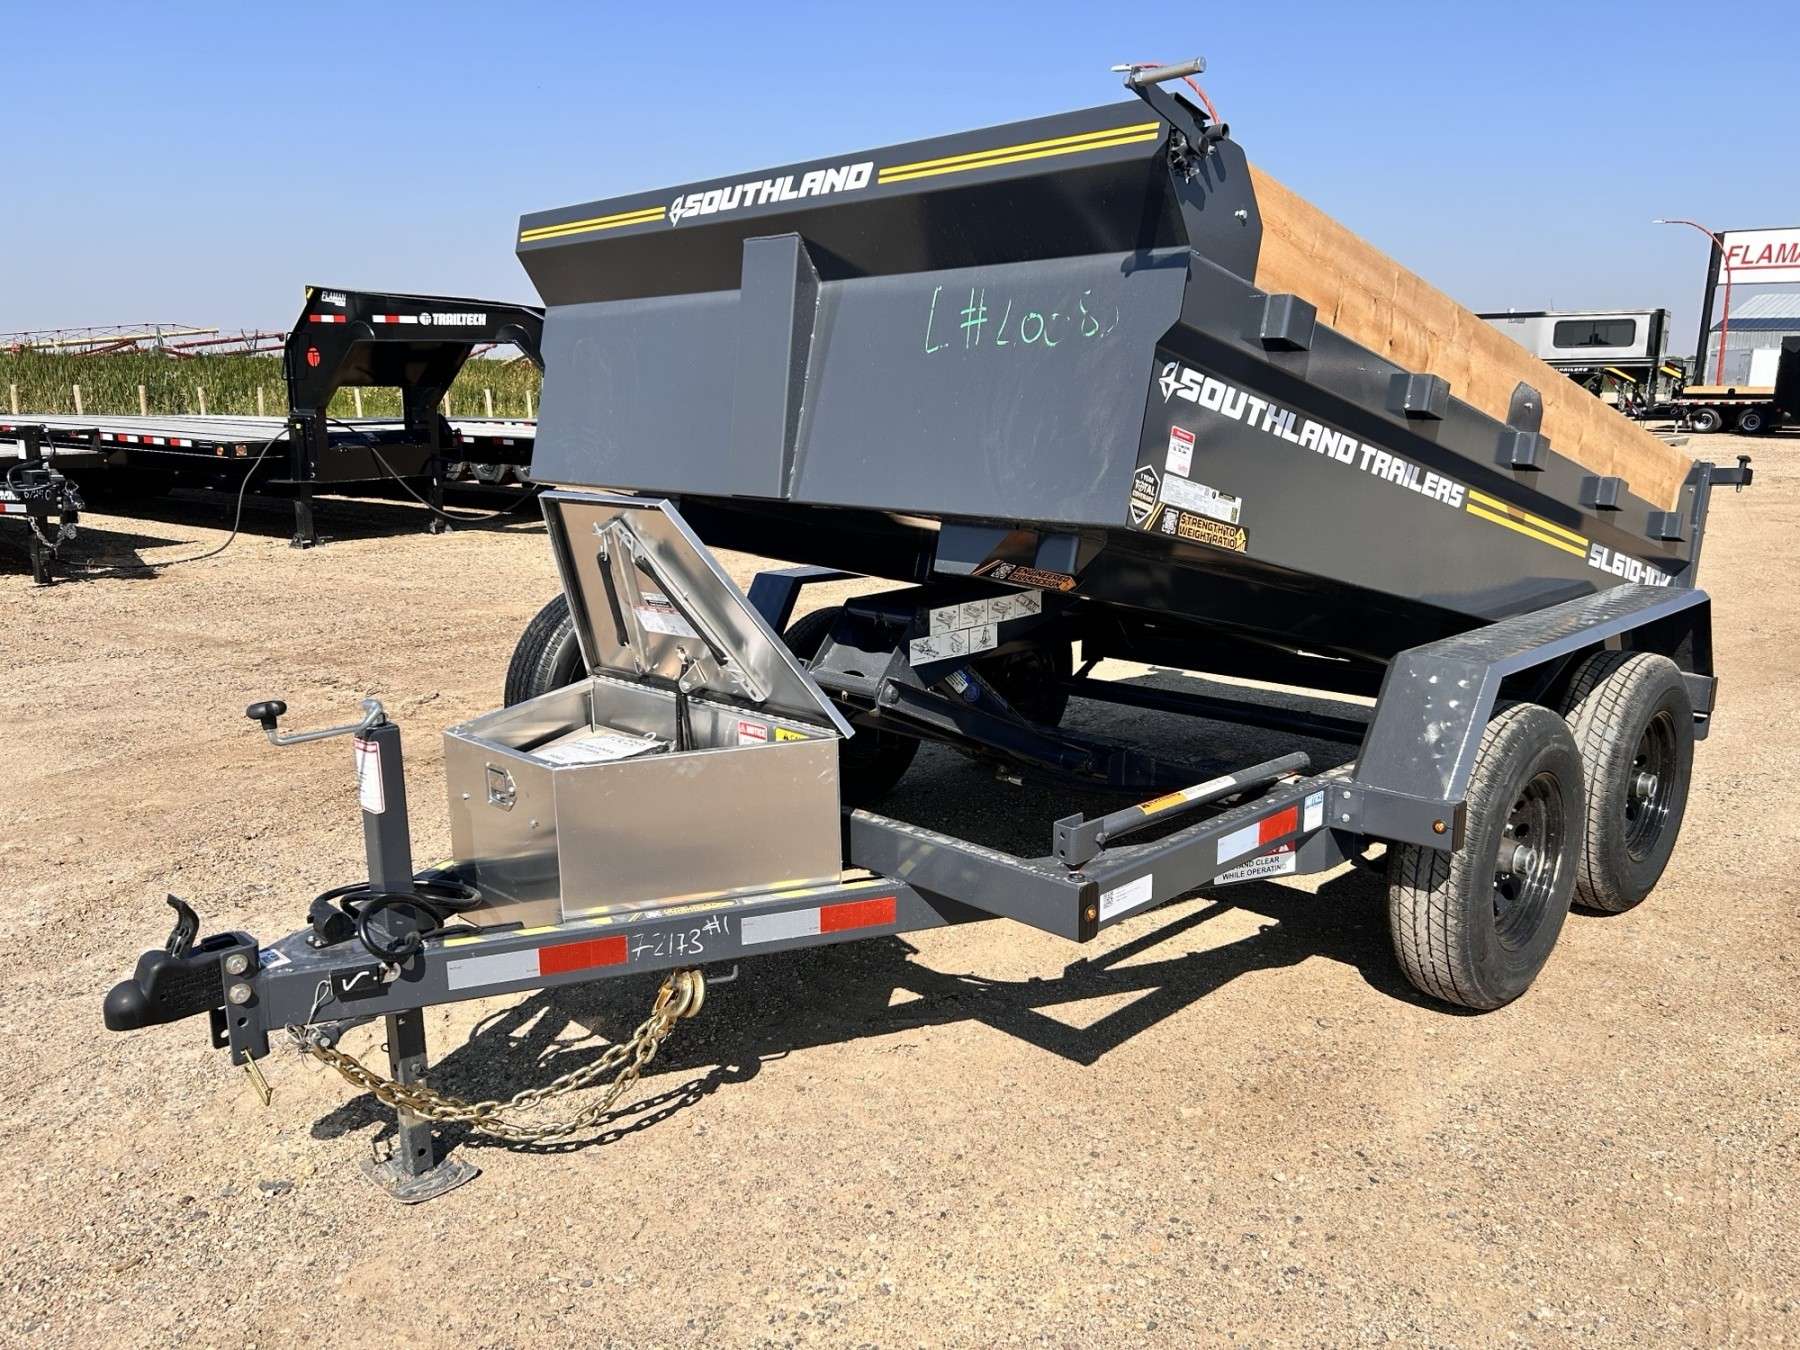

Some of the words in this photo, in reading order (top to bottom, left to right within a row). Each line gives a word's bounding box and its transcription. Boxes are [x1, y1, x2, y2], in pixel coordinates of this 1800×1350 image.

[681, 161, 874, 218] SOUTHLAND
[432, 313, 487, 326] TRAILTECH
[1177, 367, 1358, 466] SOUTHLAND
[1360, 444, 1466, 509] TRAILERS
[1181, 514, 1224, 535] STRENGTH
[1179, 527, 1212, 543] WEIGHT
[1212, 534, 1235, 548] RATIO
[1256, 856, 1280, 866] CLEAR
[1222, 871, 1245, 880] WHILE
